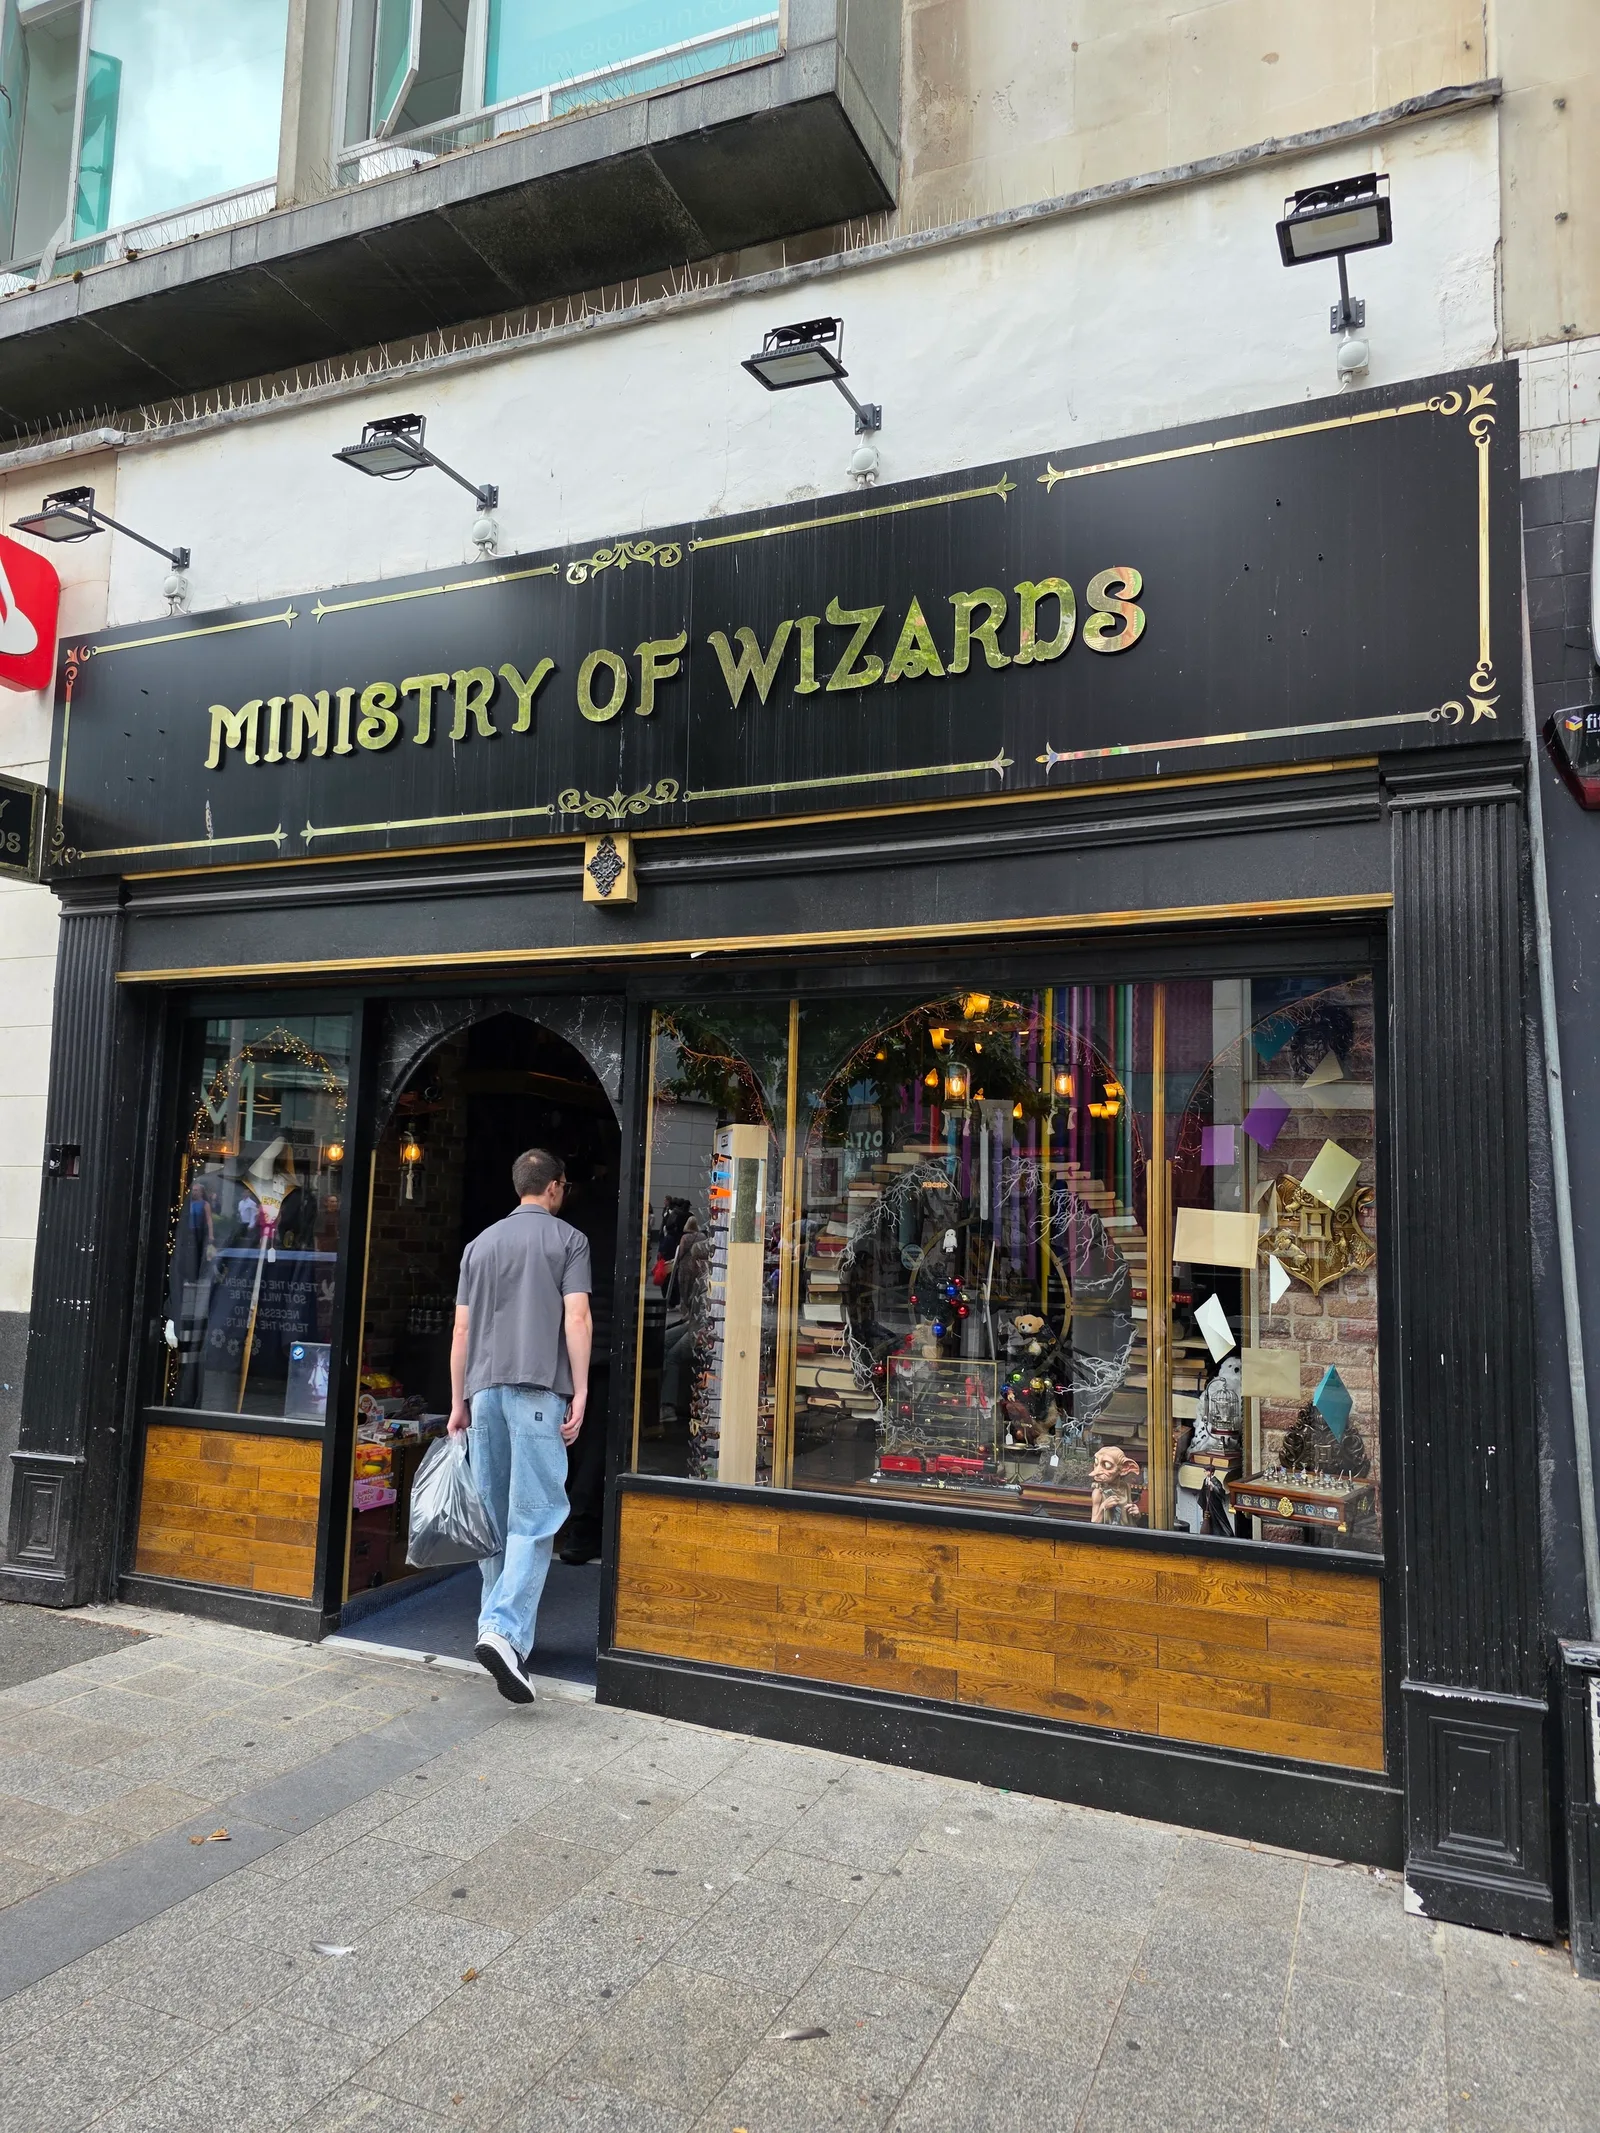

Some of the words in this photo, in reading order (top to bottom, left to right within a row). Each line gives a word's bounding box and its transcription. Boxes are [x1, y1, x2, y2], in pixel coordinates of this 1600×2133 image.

[204, 657, 555, 770] MINISTRY
[577, 630, 688, 722] OF
[707, 566, 1146, 709] WIZARDS
